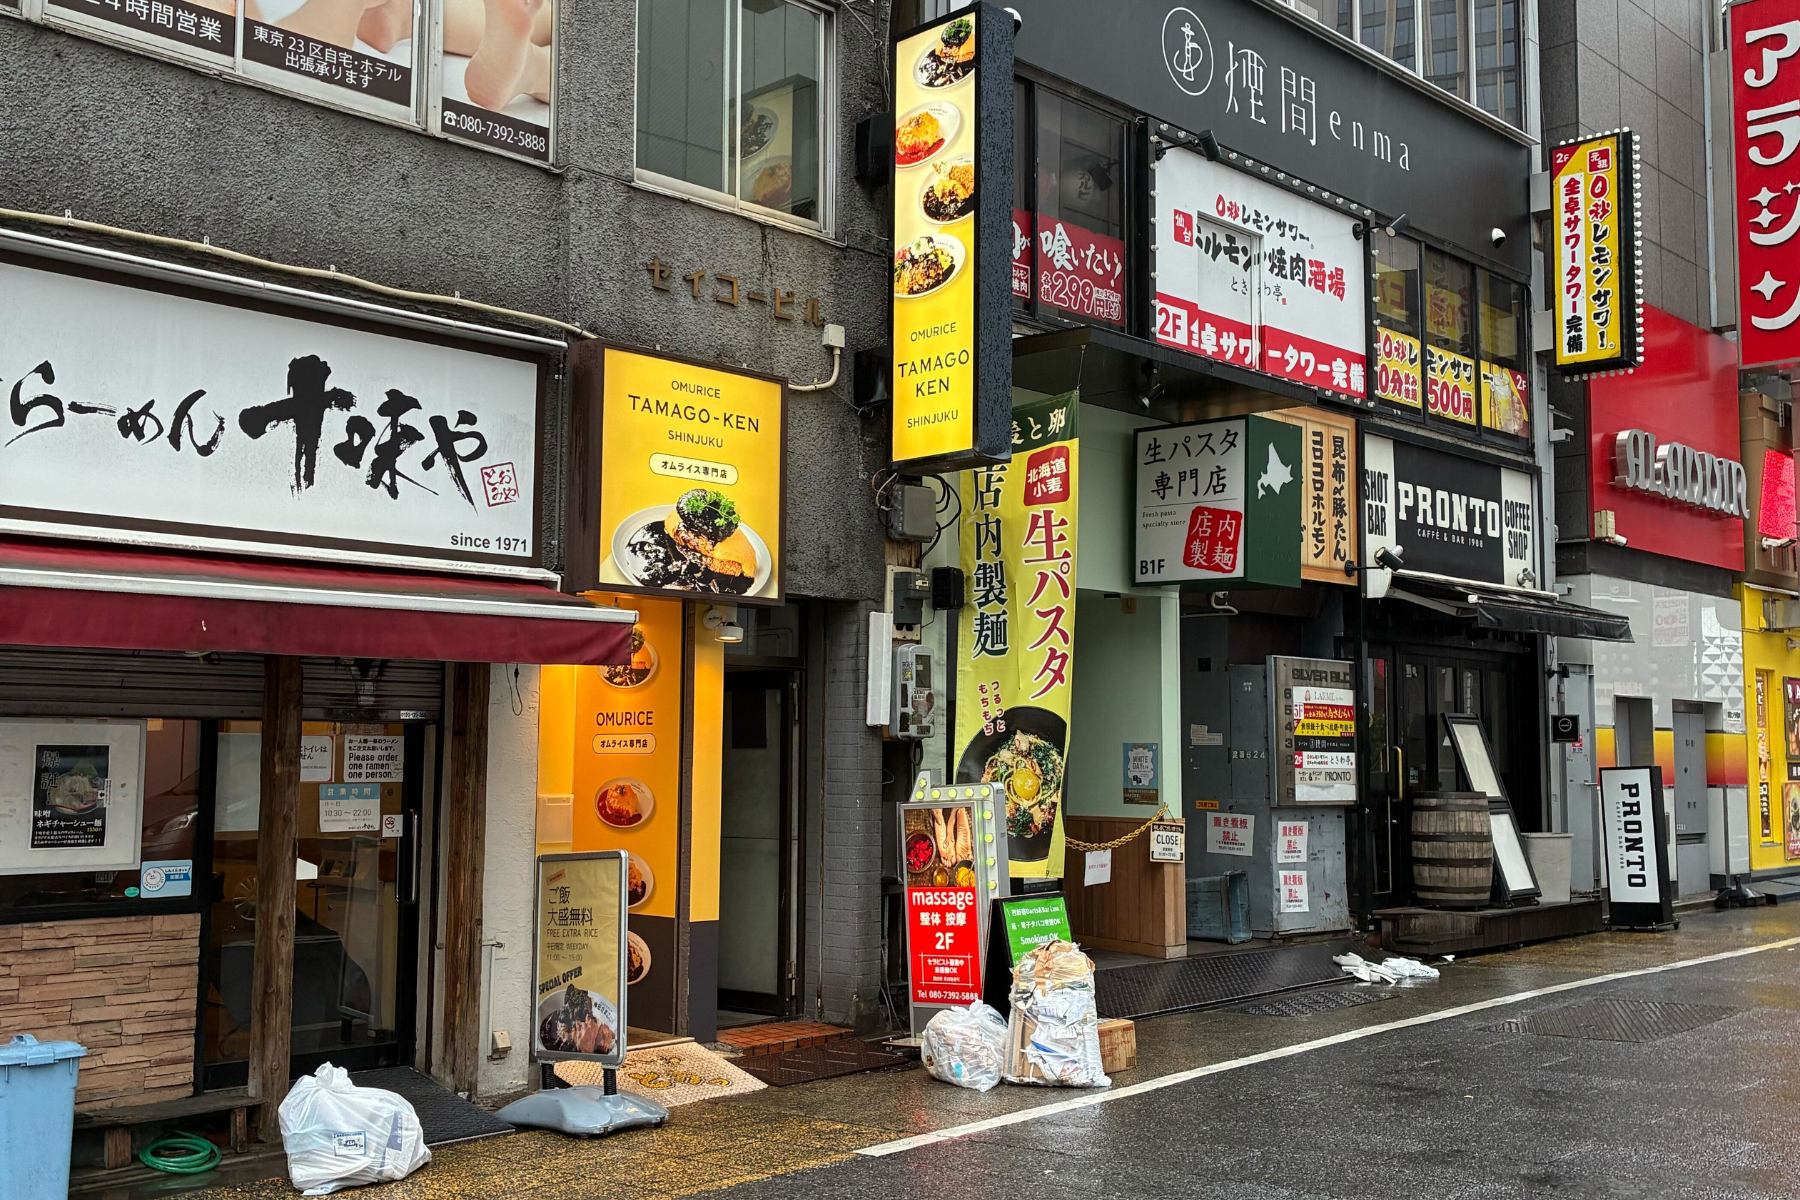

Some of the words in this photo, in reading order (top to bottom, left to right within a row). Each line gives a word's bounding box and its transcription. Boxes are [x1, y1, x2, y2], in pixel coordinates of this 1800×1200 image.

[253, 25, 285, 48] 東京
[288, 37, 306, 54] 23
[308, 42, 402, 83] 区自宅・ホテル
[284, 52, 373, 88] 出張承ります
[1329, 110, 1410, 171] enma
[1555, 152, 1570, 164] 2F
[1590, 151, 1608, 171] 元祖
[1078, 172, 1092, 201] カルビ
[1174, 212, 1192, 243] 仙台
[1563, 176, 1583, 354] 全卓サワータワー完備
[646, 256, 826, 328] セイコービル
[910, 322, 957, 342] OMURICE
[1157, 307, 1182, 339] 2F
[897, 349, 970, 378] TAMAGO
[671, 380, 721, 399] OMURICE
[915, 376, 950, 398] KEN
[1427, 376, 1473, 421] 500円
[628, 394, 760, 433] TAMAGO-KEN
[907, 409, 959, 429] SHINJUKU
[238, 354, 489, 516] 十味や
[668, 430, 724, 448] SHINJUKU
[1143, 428, 1239, 466] 生パスタ
[660, 459, 728, 480] オムライス専門店
[1028, 457, 1068, 484] 北海道
[1033, 477, 1063, 498] 小麦
[1151, 465, 1227, 501] 専門店
[1365, 468, 1389, 504] SHOT
[1312, 430, 1326, 559] コロコロホルモン
[1142, 511, 1159, 519] Fresh
[1160, 510, 1177, 519] pasta
[1367, 503, 1387, 537] BAR
[1397, 481, 1501, 539] PRONTO
[1504, 499, 1531, 532] COFFEE
[1190, 510, 1236, 541] 店内
[450, 532, 491, 549] since
[495, 536, 527, 553] 1971
[1443, 532, 1448, 542] &
[1451, 534, 1465, 545] BAR
[1507, 530, 1528, 561] SHOP
[1140, 558, 1166, 575] B1F
[1022, 508, 1072, 700] 生パスタ
[1292, 668, 1328, 683] SILVER
[1284, 688, 1292, 700] 6
[596, 711, 654, 727] OMURICE
[978, 683, 994, 736] もちもち
[1285, 704, 1292, 715] 5
[1285, 721, 1293, 733] 4
[600, 739, 648, 749] オムライス専門店
[1285, 738, 1293, 749] 3
[348, 753, 375, 762] Please
[377, 753, 399, 762] order
[348, 763, 363, 771] one
[366, 763, 390, 771] ramen
[348, 771, 363, 779] one
[1324, 771, 1352, 782] PRONTO
[36, 819, 103, 828] ネギチャーシュー麺
[324, 809, 343, 817] 10:30
[1156, 833, 1179, 846] CLOSE
[1222, 830, 1239, 842] 禁止
[1621, 783, 1647, 888] PRONTO
[548, 885, 571, 905] ご飯
[912, 890, 974, 911] massage
[547, 906, 594, 927] 大盛無料
[919, 911, 942, 927] 整体
[945, 911, 967, 927] 按摩
[547, 928, 560, 938] FREE
[562, 928, 582, 938] EXTRA
[584, 928, 599, 938] RICE
[935, 932, 954, 951] 2F
[1020, 933, 1048, 946] Smoking
[566, 943, 590, 951] WEEKDAY
[538, 975, 563, 995] SPECIAL
[562, 966, 583, 985] OFFER
[917, 989, 928, 999] Tel
[928, 990, 979, 1001] 080-7392-5888
